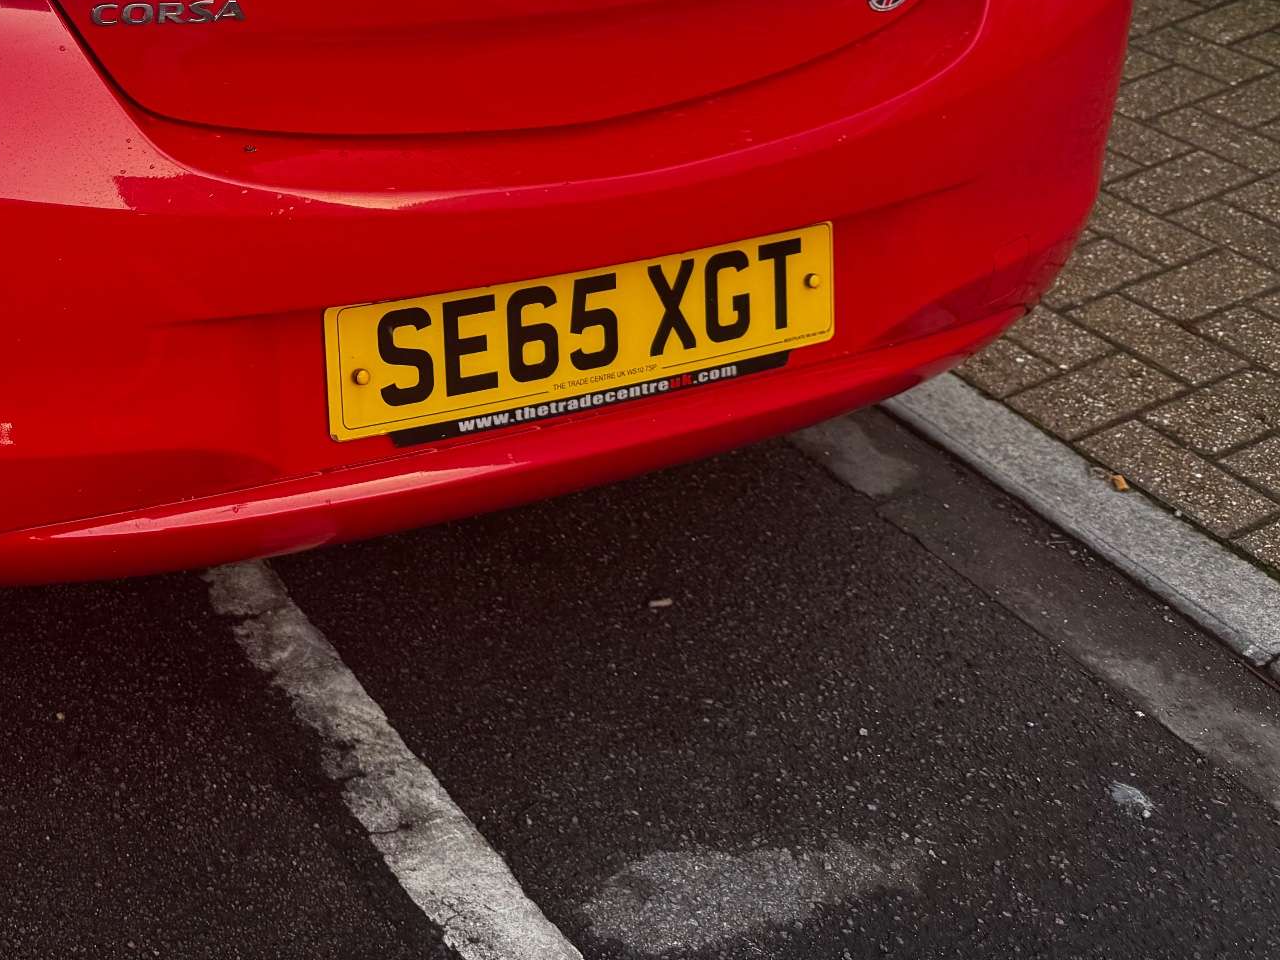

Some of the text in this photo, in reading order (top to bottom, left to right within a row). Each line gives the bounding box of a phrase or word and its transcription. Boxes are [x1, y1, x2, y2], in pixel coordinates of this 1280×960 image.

[376, 236, 802, 408] SE65 XGT
[458, 363, 738, 433] www.thetradecentreuk.com
[553, 383, 566, 391] THE
[568, 378, 588, 388] TRADE
[589, 372, 616, 384] CENTRE
[616, 369, 626, 378] UK
